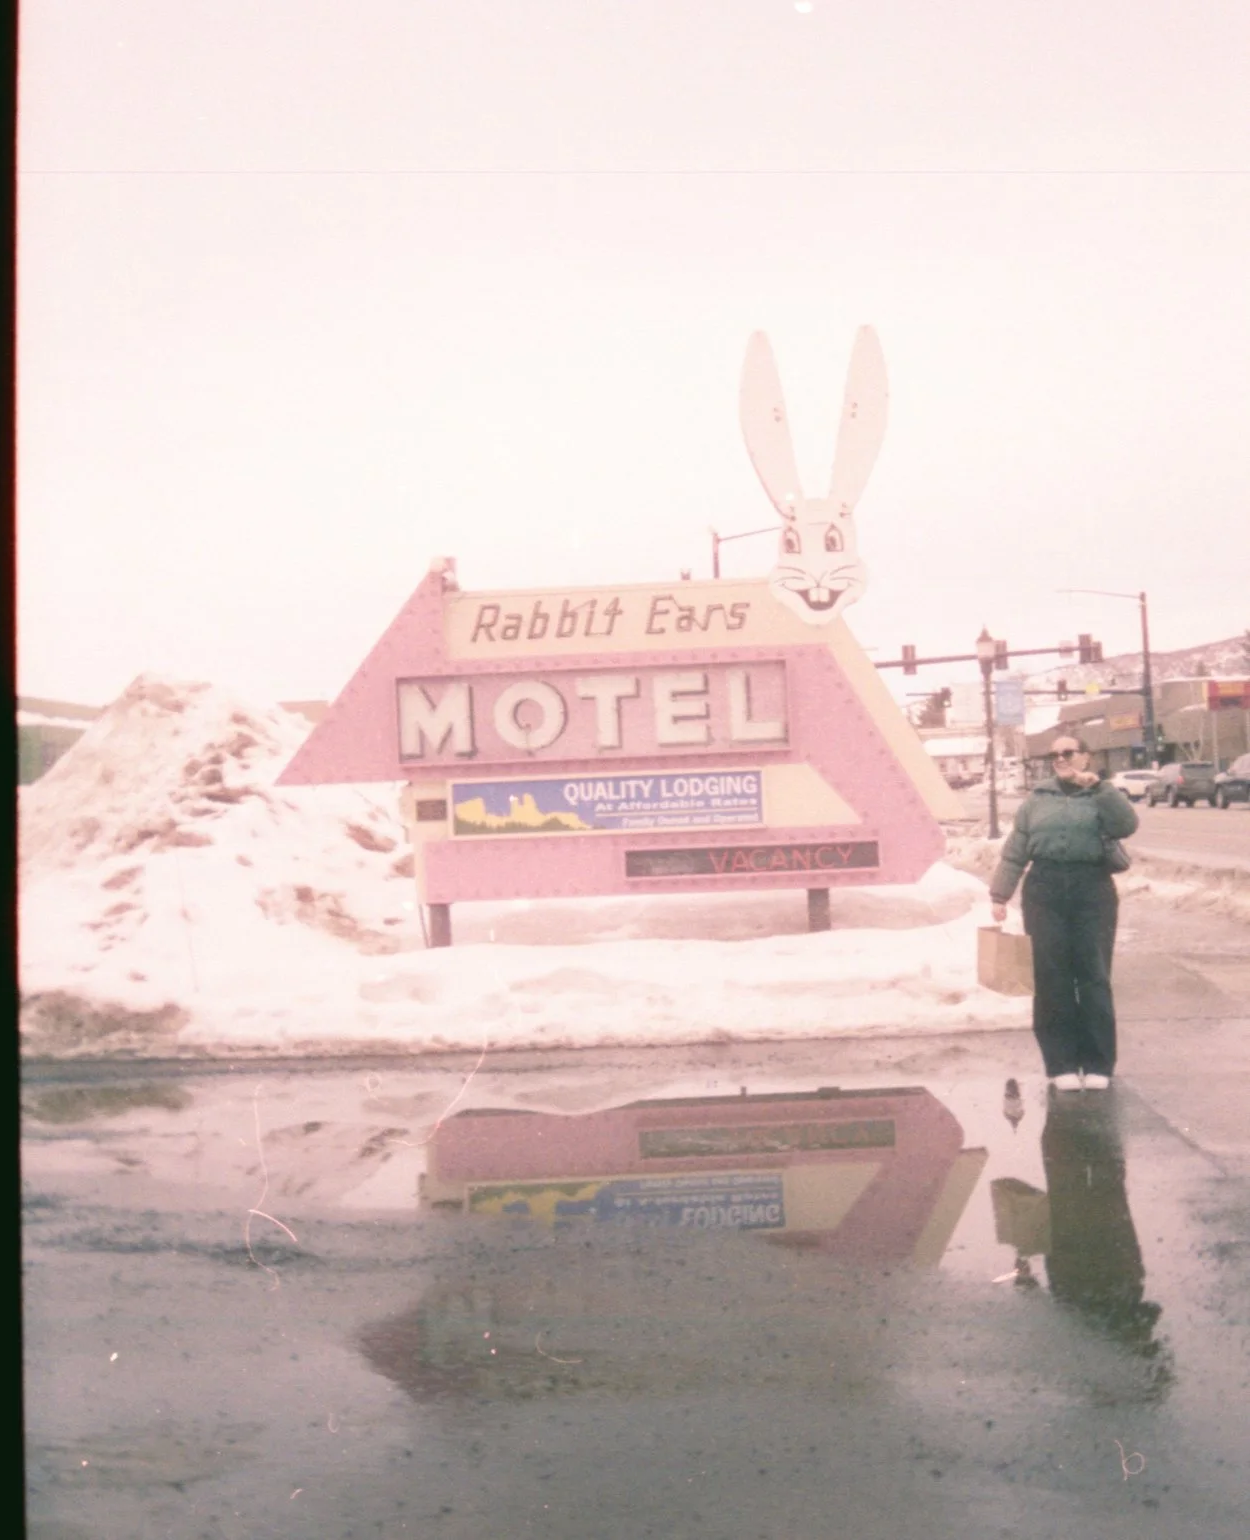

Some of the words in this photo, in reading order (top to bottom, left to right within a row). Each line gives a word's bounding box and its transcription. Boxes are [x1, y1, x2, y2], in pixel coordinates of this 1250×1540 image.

[470, 597, 623, 643] Rabbit
[644, 594, 751, 637] Ears
[400, 671, 788, 758] MOTEL
[563, 778, 655, 806] QUALITY
[660, 775, 758, 798] LODGING
[594, 802, 613, 812] At
[618, 799, 705, 812] Affordable
[710, 798, 758, 808] Rates
[708, 845, 856, 874] VACANCY
